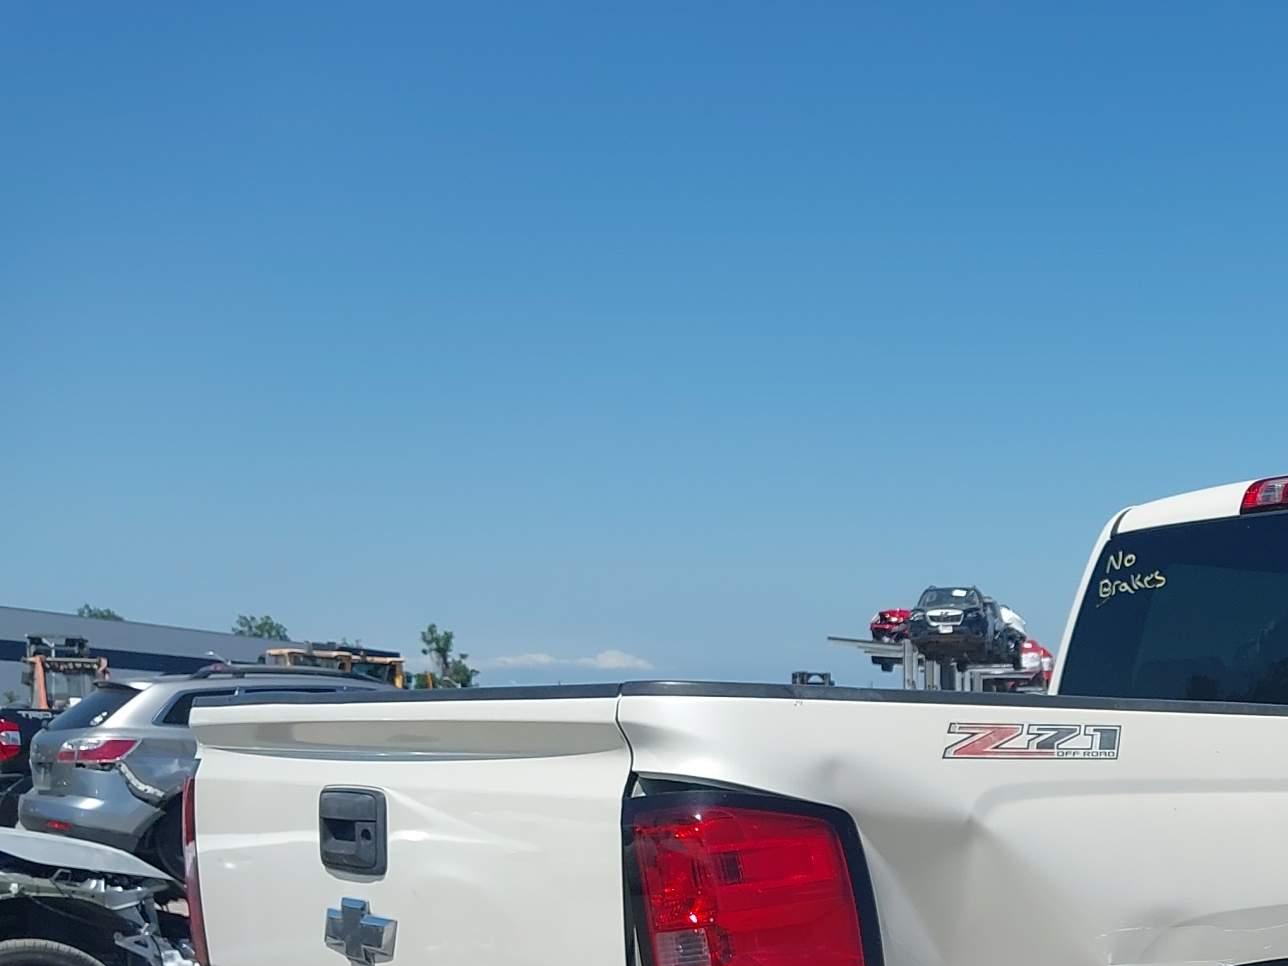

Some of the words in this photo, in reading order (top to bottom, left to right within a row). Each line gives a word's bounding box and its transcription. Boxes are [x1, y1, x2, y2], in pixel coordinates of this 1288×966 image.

[1106, 551, 1136, 574] No
[1099, 571, 1166, 598] Brakes
[942, 722, 1122, 760] Z71
